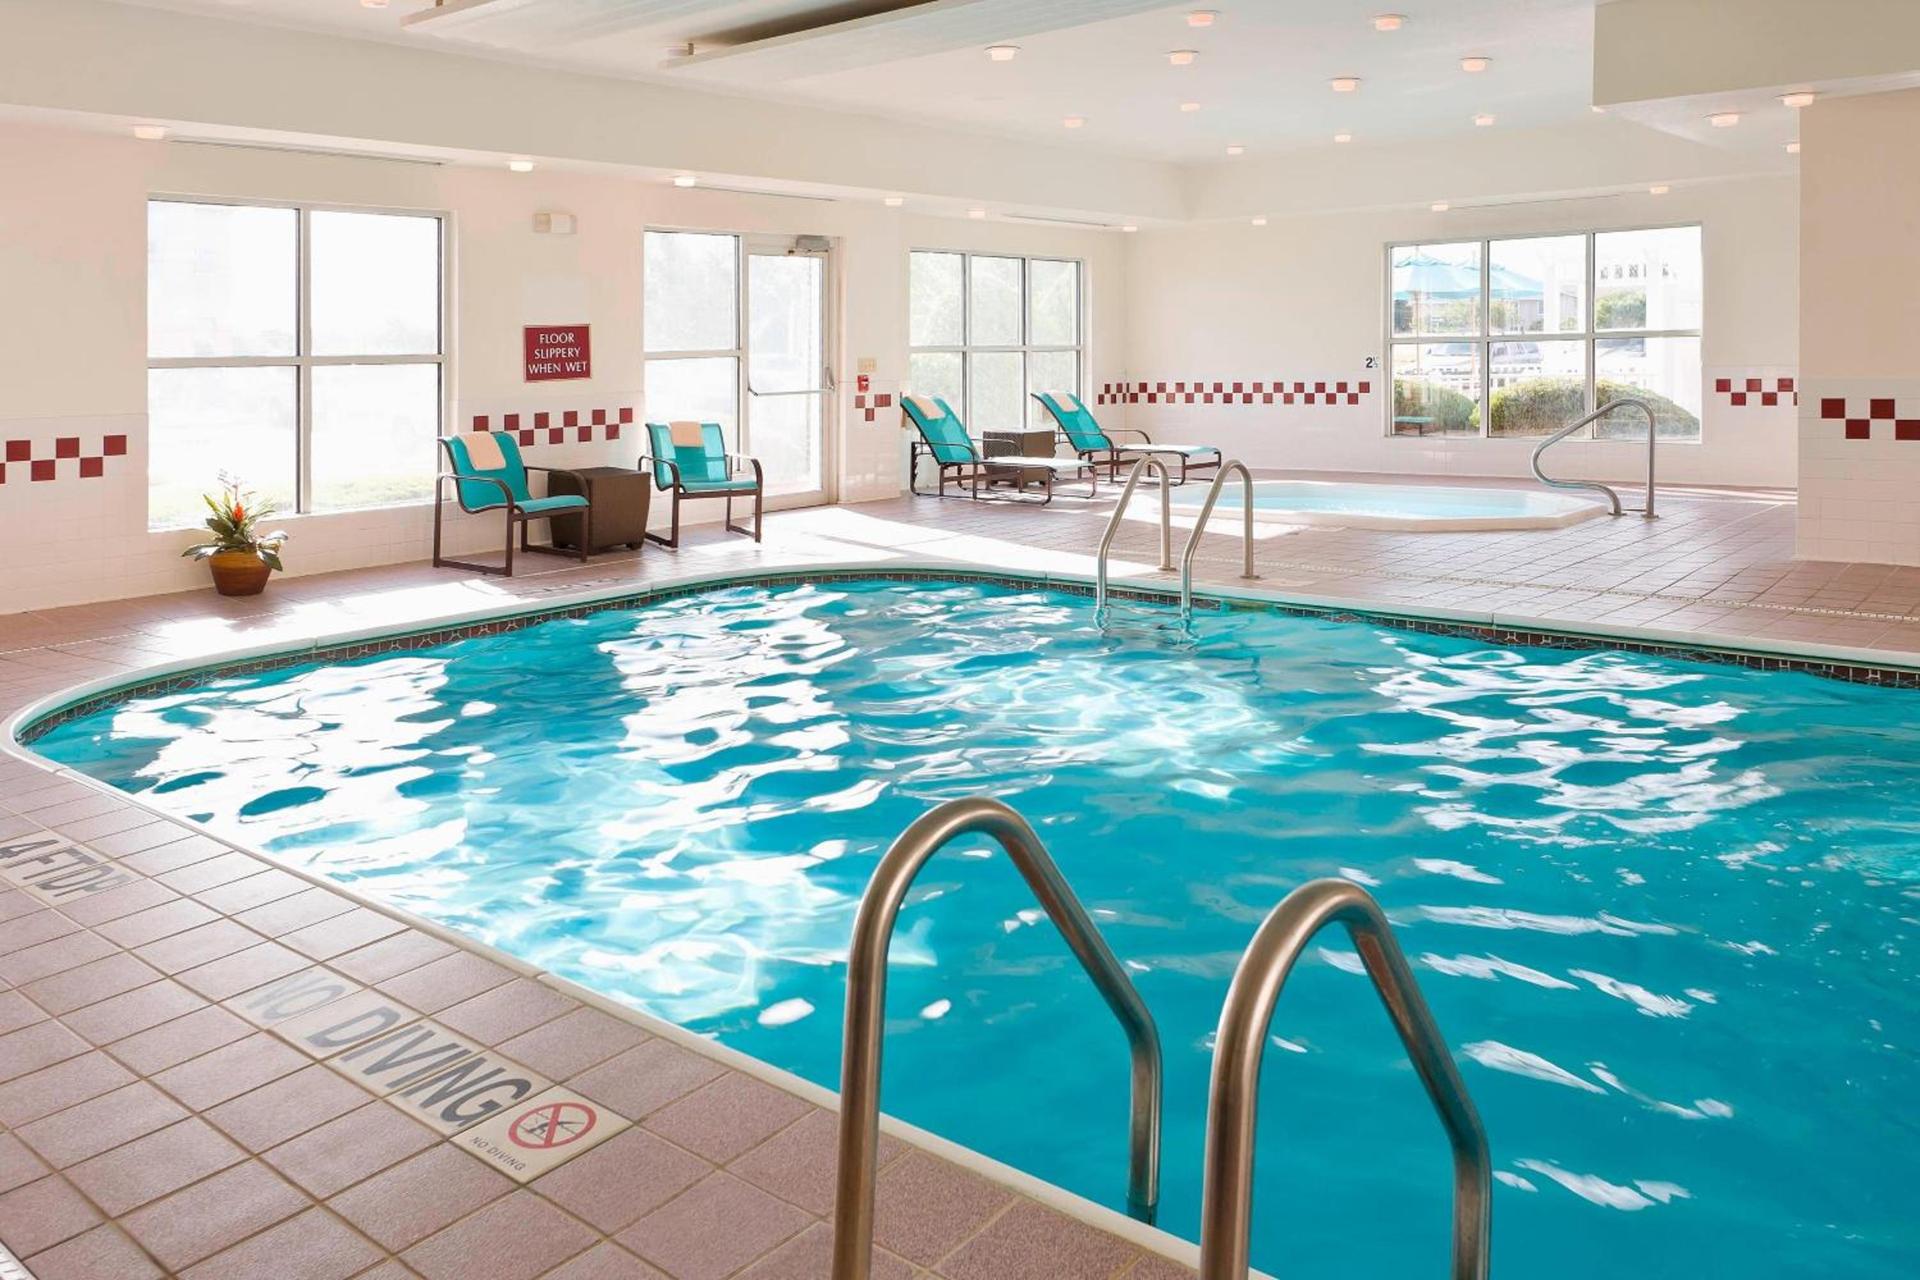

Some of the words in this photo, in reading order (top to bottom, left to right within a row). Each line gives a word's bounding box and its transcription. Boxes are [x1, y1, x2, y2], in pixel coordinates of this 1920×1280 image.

[540, 332, 575, 344] FLOOR
[534, 347, 580, 359] SLIPPERY
[528, 363, 560, 374] WHEN
[565, 361, 587, 372] WET
[248, 970, 346, 1019] NO
[304, 1006, 532, 1126] DIVING
[471, 1136, 488, 1149] NO
[487, 1144, 526, 1171] DIVING
